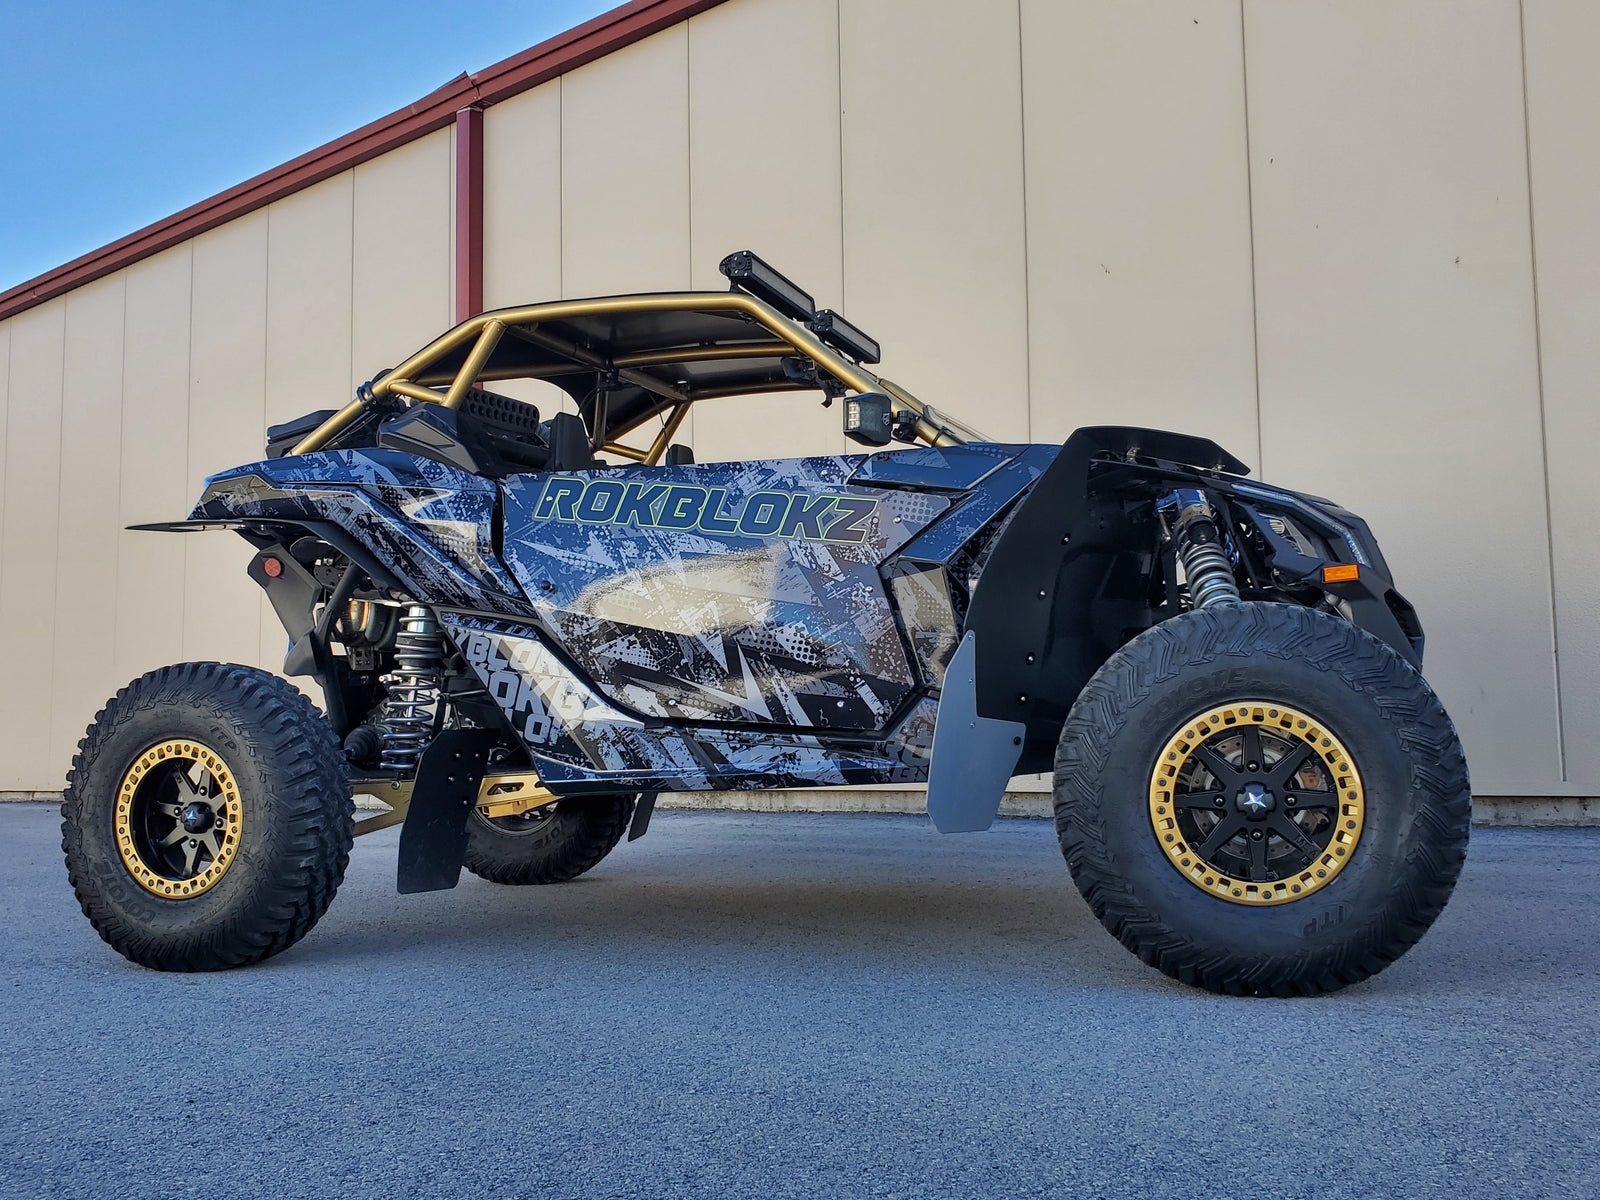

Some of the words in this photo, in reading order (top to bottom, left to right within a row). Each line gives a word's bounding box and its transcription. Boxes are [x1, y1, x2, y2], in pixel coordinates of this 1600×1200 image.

[534, 477, 878, 544] ROKBLOKZ
[210, 727, 237, 750] ITP
[1303, 904, 1344, 937] ITP
